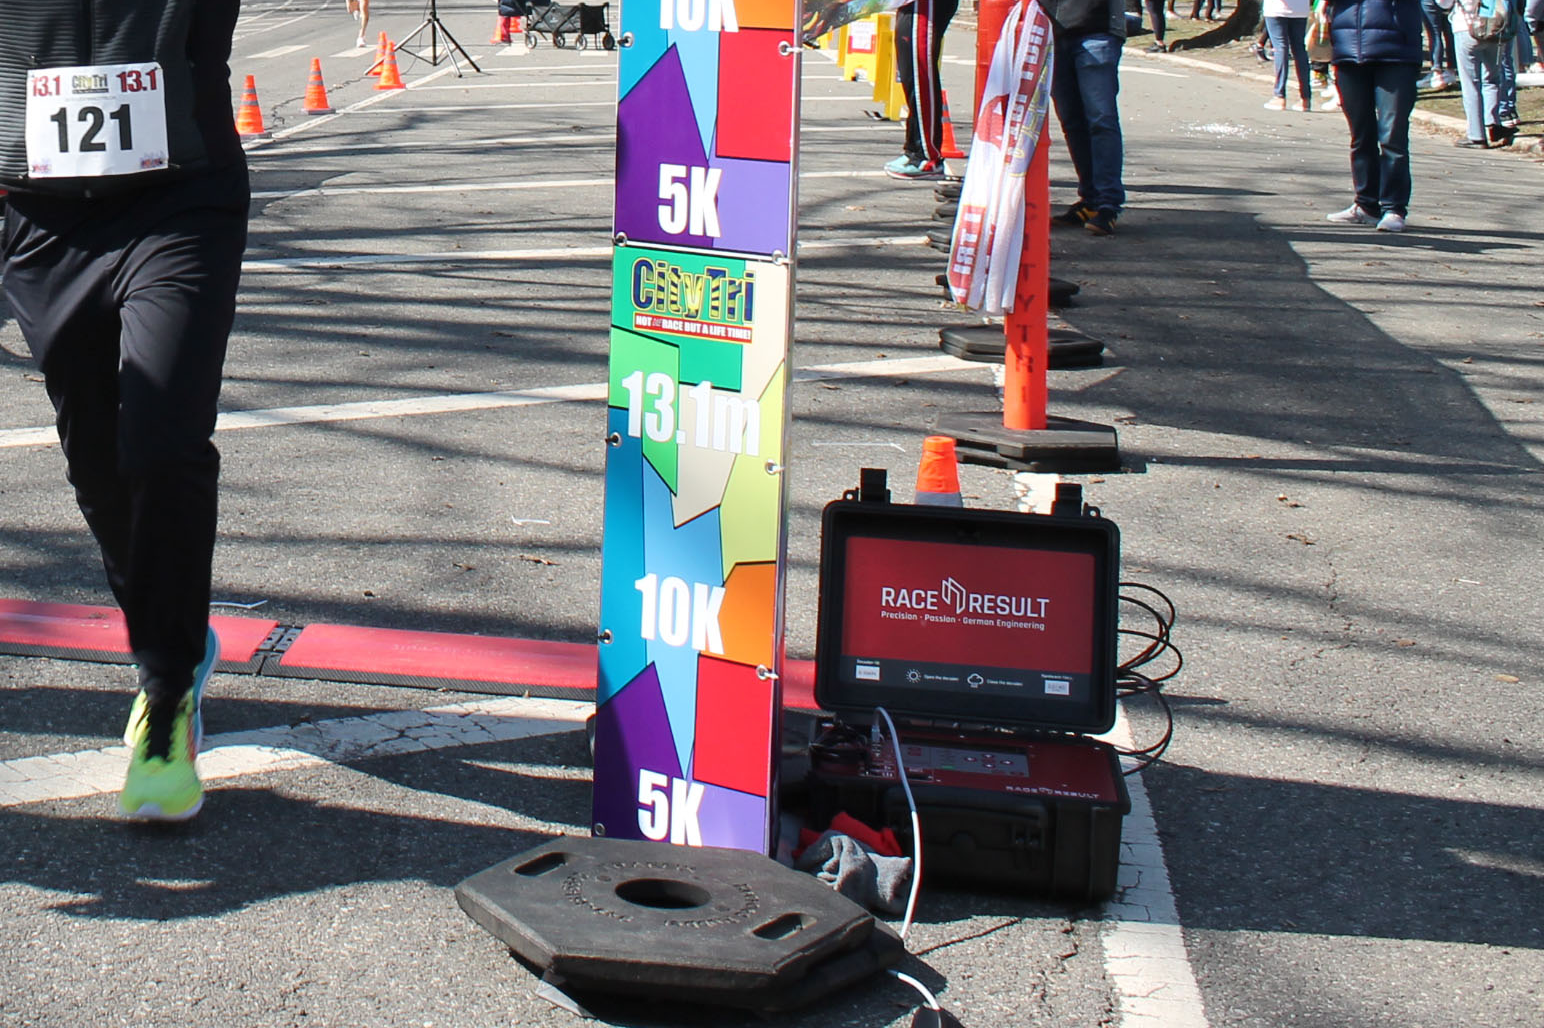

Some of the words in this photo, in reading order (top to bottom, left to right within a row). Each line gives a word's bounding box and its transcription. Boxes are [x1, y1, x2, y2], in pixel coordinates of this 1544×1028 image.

[32, 75, 61, 97] 13.1
[116, 68, 157, 93] 13.1
[50, 104, 133, 153] 121
[656, 163, 723, 238] 5K
[632, 257, 755, 323] CityTri
[636, 315, 652, 327] NOT
[662, 318, 684, 331] RACE
[684, 321, 702, 333] BUT
[702, 324, 709, 334] A
[709, 325, 727, 336] LIFE
[621, 370, 761, 457] 13.1m
[634, 573, 727, 656] 10K
[880, 610, 918, 621] Precision
[924, 613, 956, 623] Passion
[963, 616, 995, 626] German
[996, 619, 1045, 631] Engineering
[881, 586, 939, 611] RACE
[968, 593, 1050, 618] RESULT
[637, 768, 707, 848] 5K
[1006, 785, 1038, 794] RACE
[1054, 789, 1100, 799] RESULT
